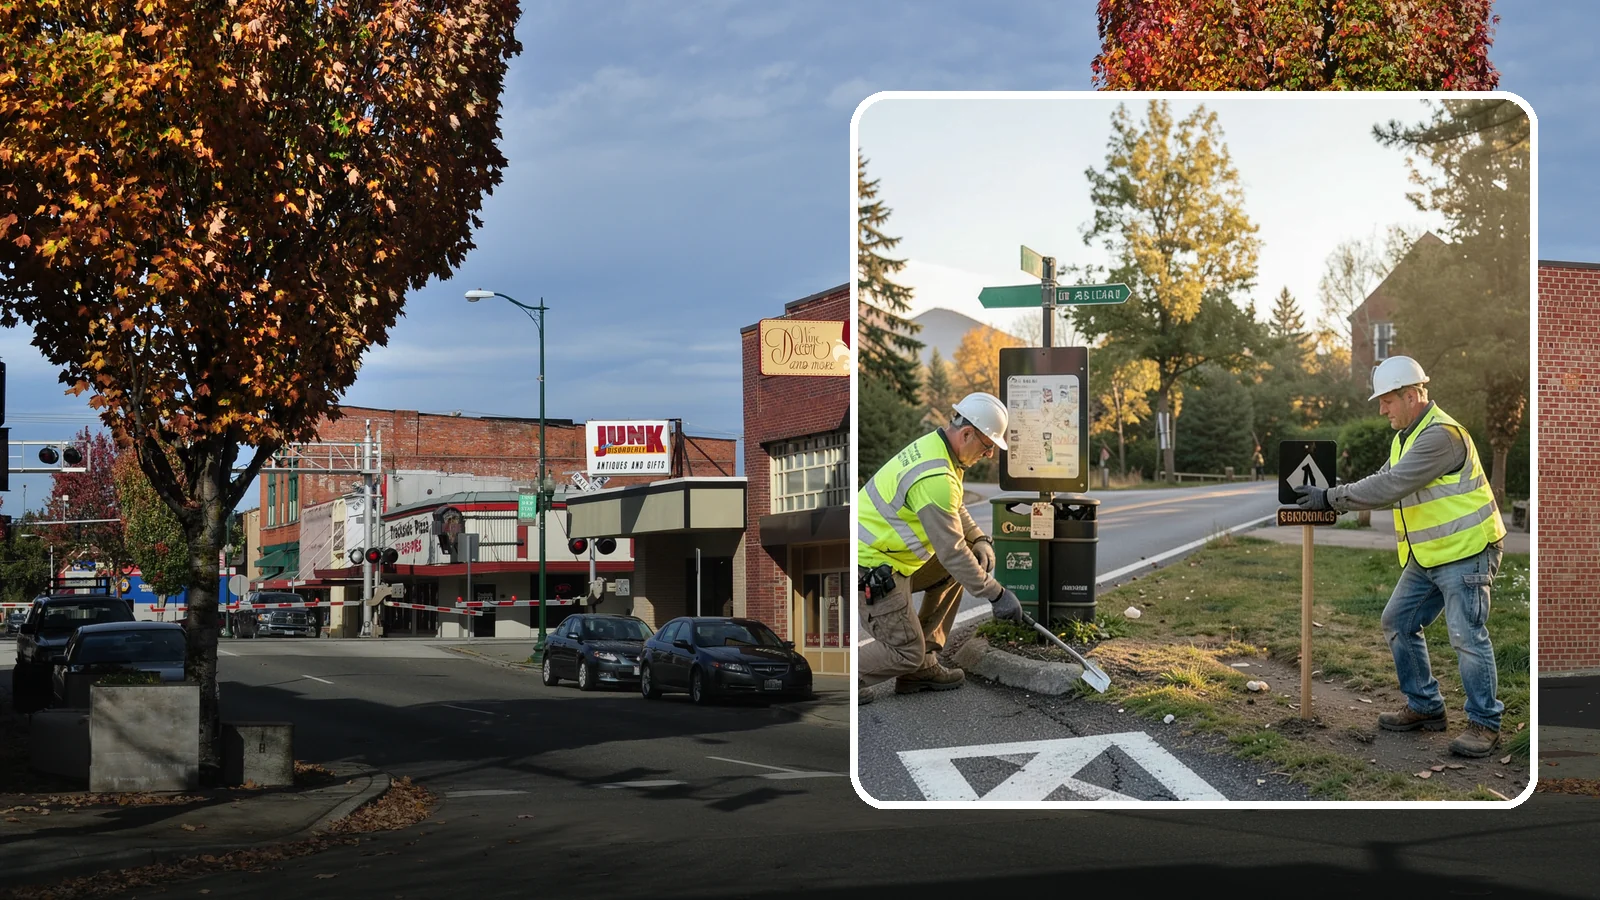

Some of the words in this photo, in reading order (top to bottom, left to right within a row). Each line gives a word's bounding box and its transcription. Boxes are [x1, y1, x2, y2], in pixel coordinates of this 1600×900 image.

[595, 425, 664, 457] JUNK
[607, 446, 645, 454] DISORDERLY
[597, 461, 628, 470] ANTIQUES
[631, 461, 643, 470] AND
[647, 460, 665, 470] GIFTS
[390, 521, 413, 540] Trackside
[414, 519, 429, 535] Pizza
